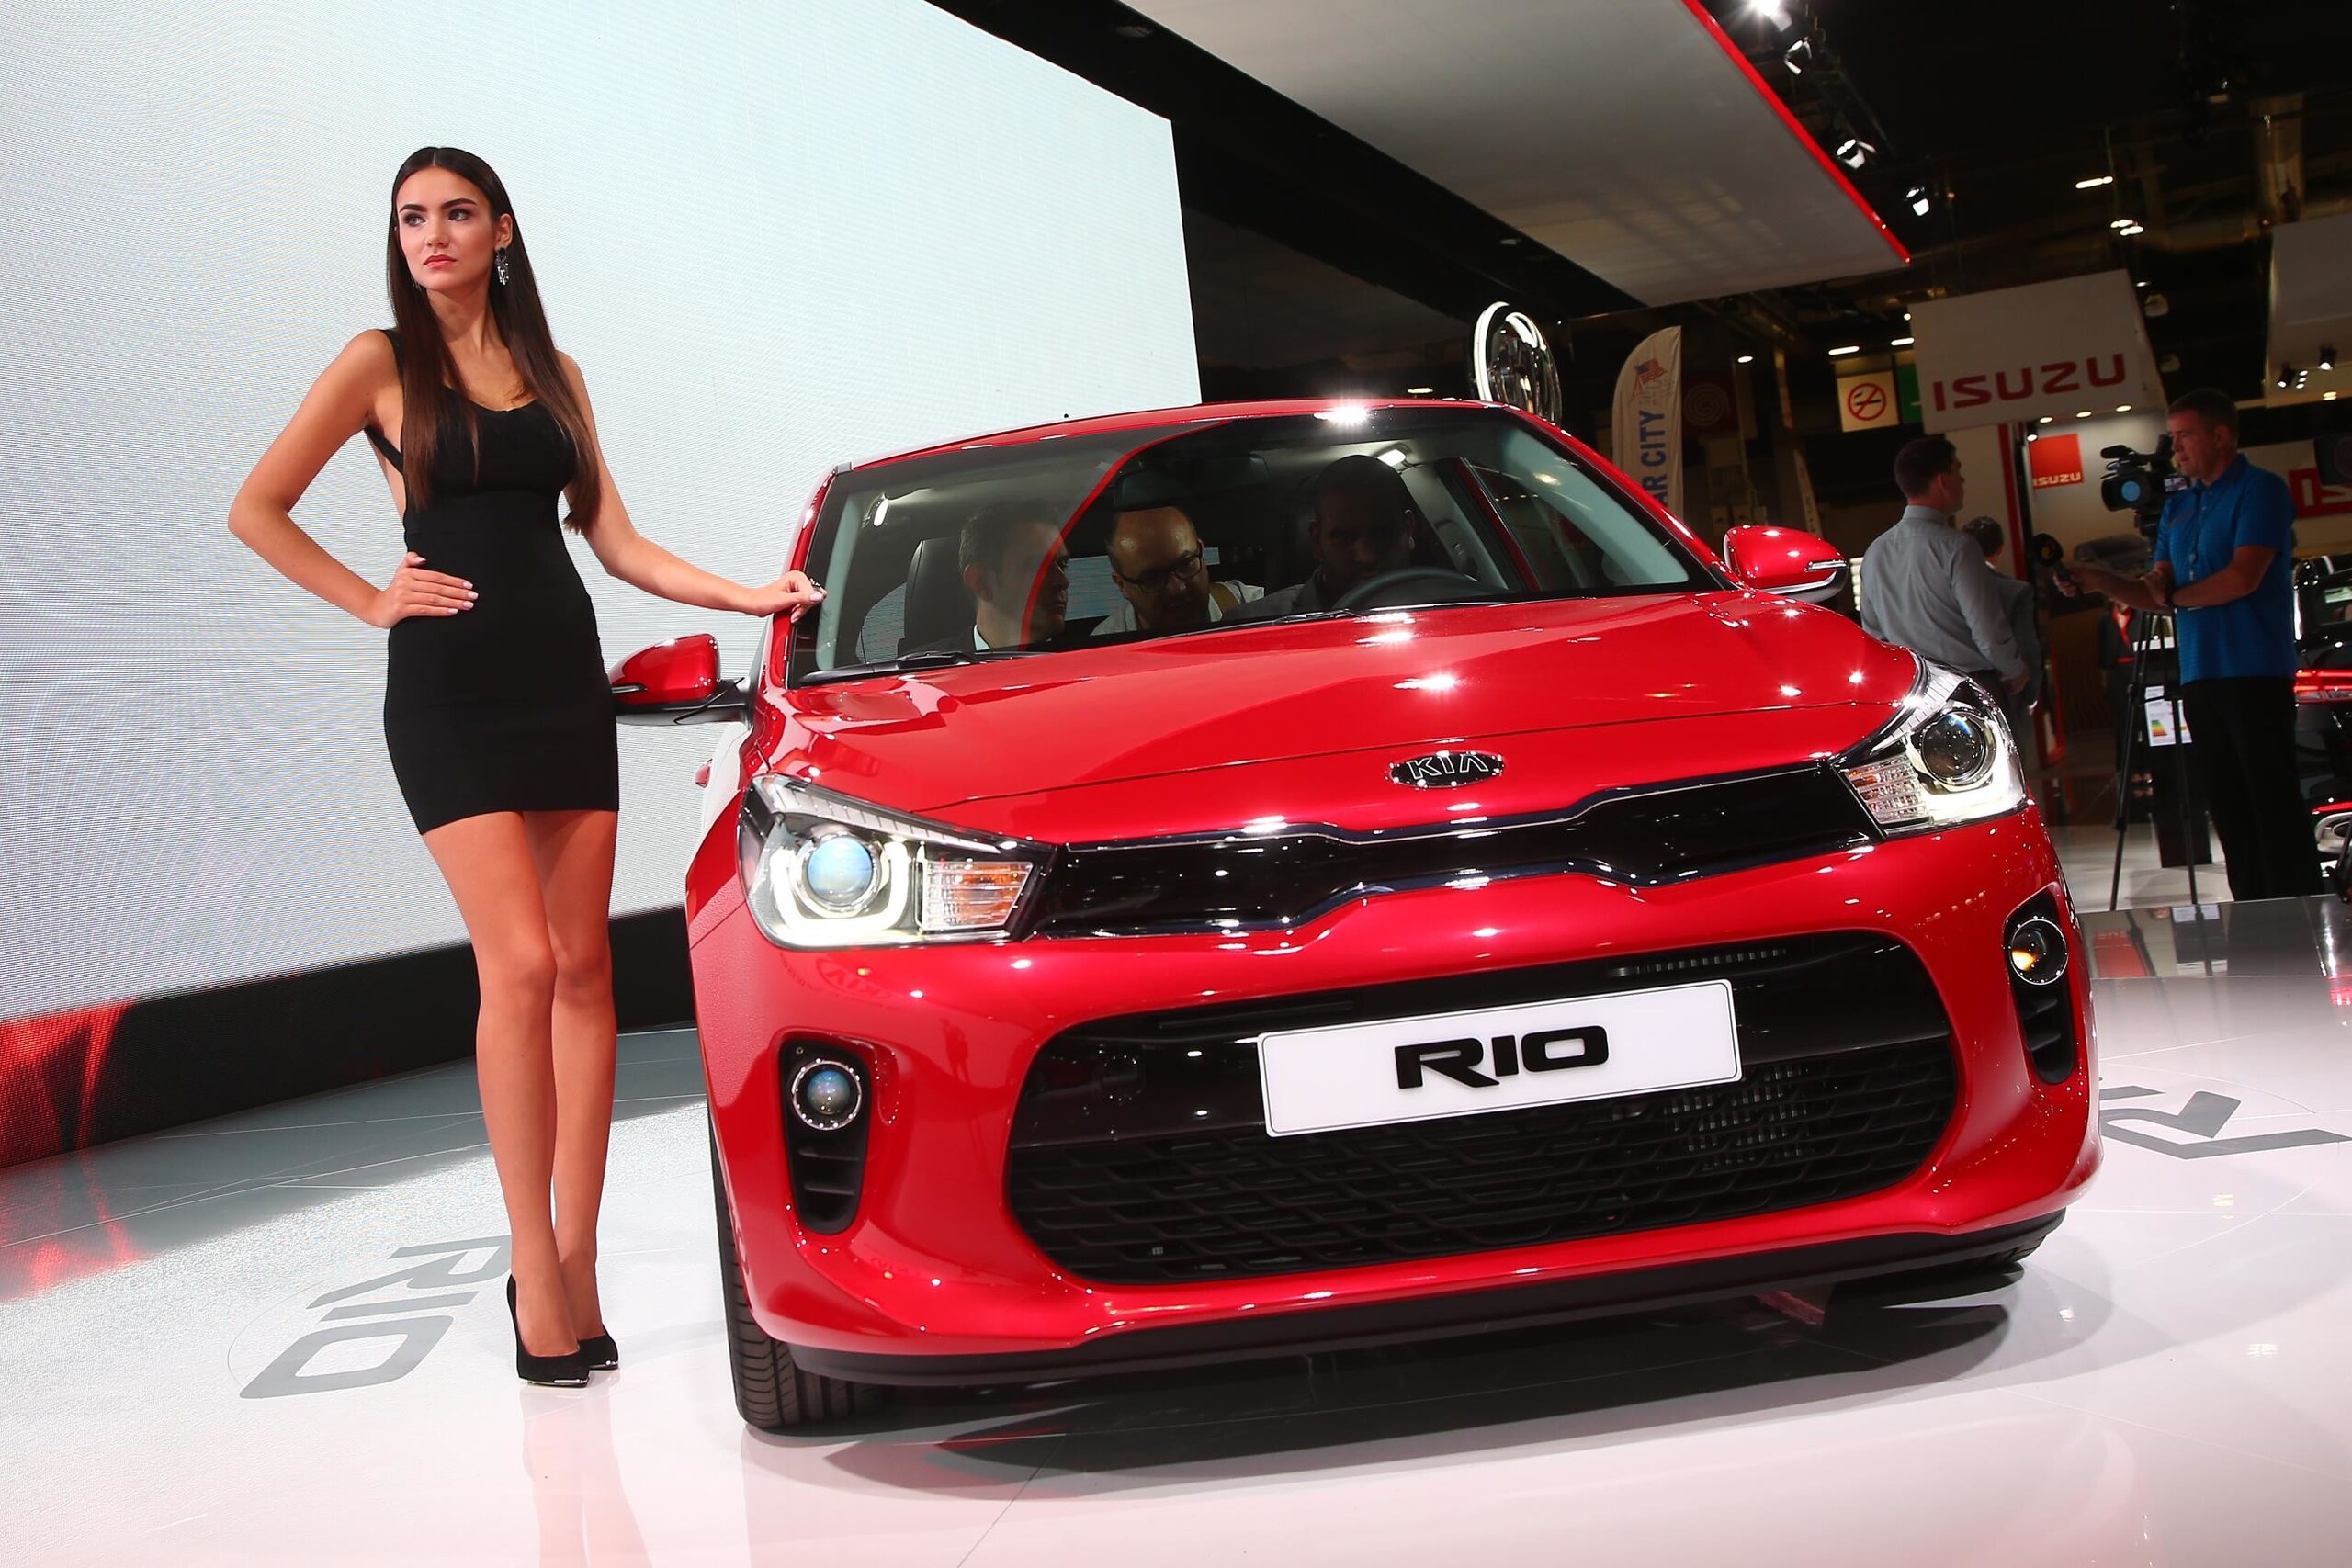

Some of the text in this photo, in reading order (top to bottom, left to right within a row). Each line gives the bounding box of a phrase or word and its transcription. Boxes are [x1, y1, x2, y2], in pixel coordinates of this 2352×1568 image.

[1933, 353, 2126, 412] ISUZU
[1638, 410, 1668, 468] CITY
[2032, 471, 2082, 486] ISUZU
[1406, 752, 1489, 780] KIA
[1394, 1024, 1610, 1090] RIO
[239, 1234, 512, 1399] RIO
